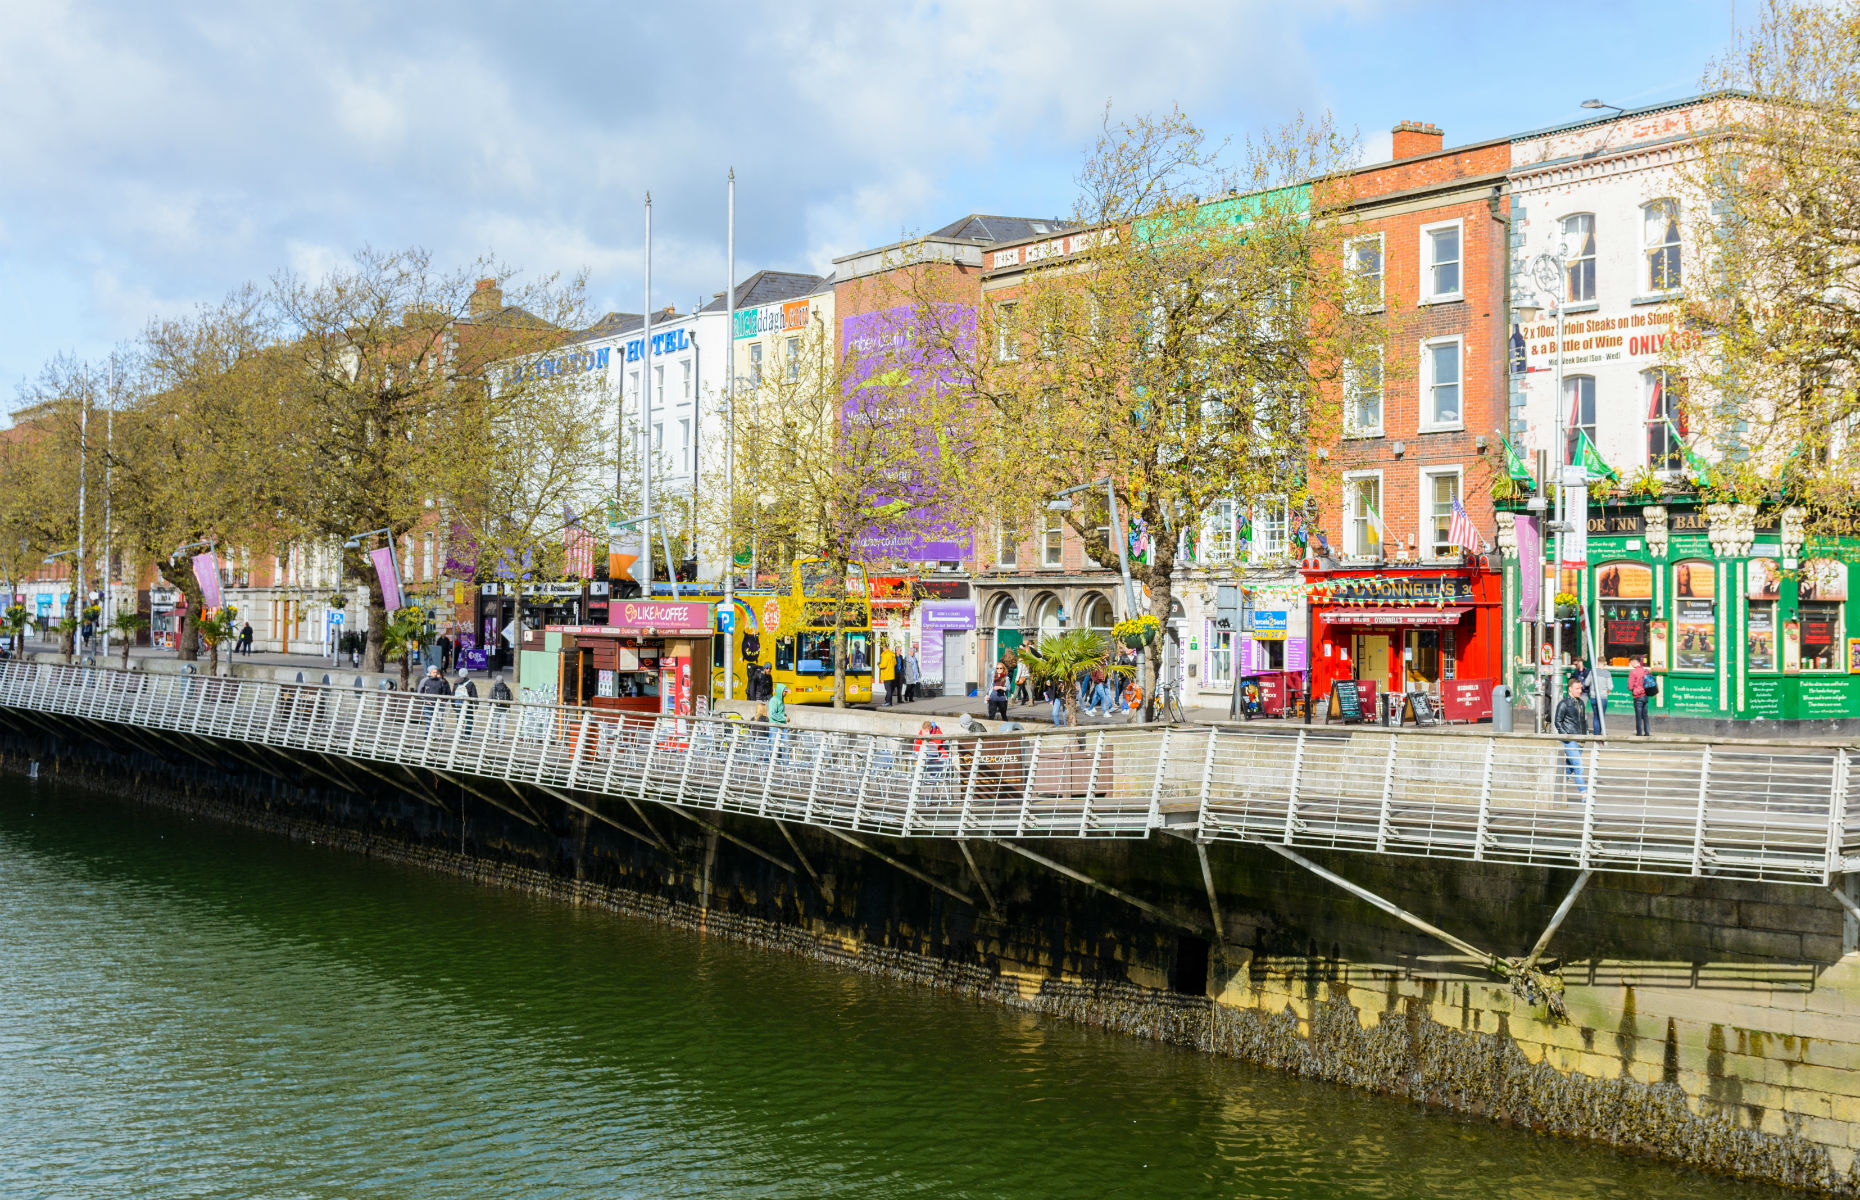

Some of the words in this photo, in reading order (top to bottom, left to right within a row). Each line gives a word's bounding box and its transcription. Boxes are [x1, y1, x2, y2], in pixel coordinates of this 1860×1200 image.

[994, 248, 1020, 269] IRISH
[1524, 328, 1528, 340] 2
[1530, 328, 1535, 338] x
[1537, 324, 1554, 337] 10oz
[1556, 321, 1584, 336] irloin
[1586, 318, 1616, 332] Steaks
[1618, 317, 1629, 329] on
[1631, 314, 1646, 327] the
[1648, 311, 1674, 325] Stone
[626, 328, 689, 362] HOTEL
[1532, 345, 1538, 355] &
[1541, 343, 1547, 354] a
[1550, 338, 1580, 353] Bttle
[1582, 336, 1593, 350] of
[1595, 334, 1623, 348] Wine
[1629, 334, 1666, 356] ONLY
[1611, 518, 1637, 531] INN
[1674, 516, 1706, 530] BAR
[1356, 583, 1455, 596] OCONNELLS
